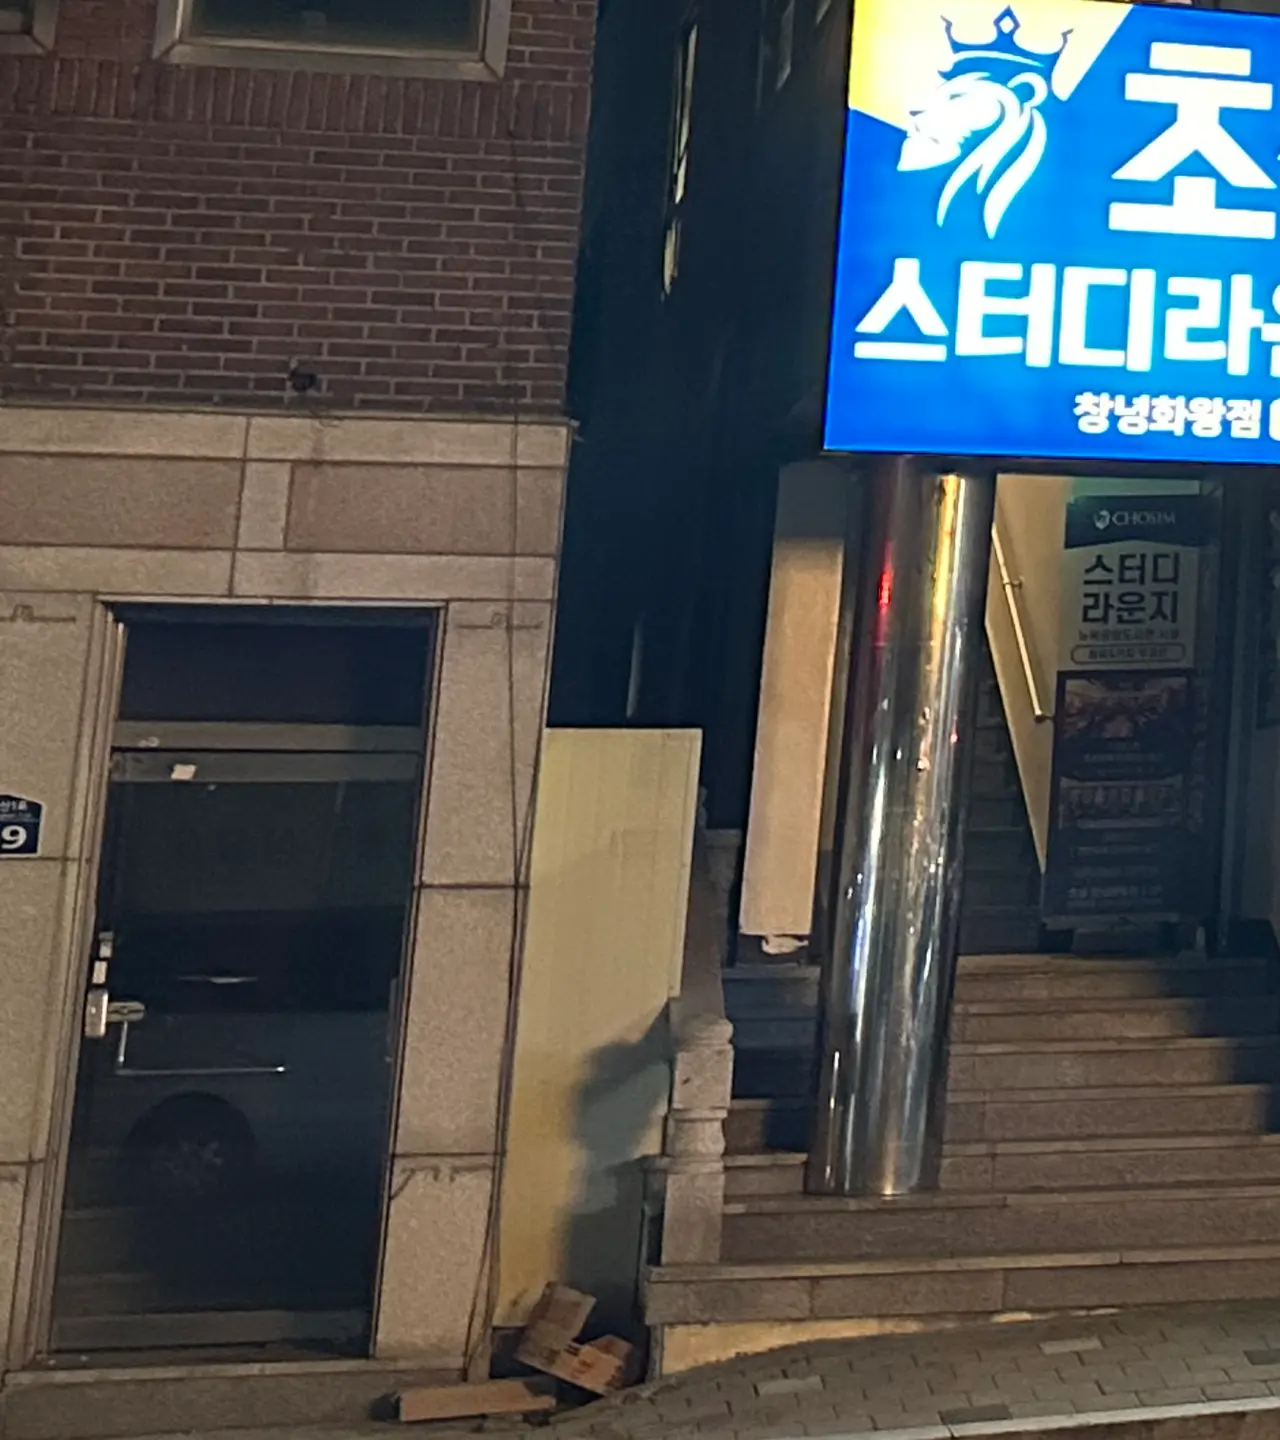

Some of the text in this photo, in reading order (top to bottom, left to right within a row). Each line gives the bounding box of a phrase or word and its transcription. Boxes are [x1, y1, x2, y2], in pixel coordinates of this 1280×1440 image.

[1074, 391, 1263, 439] 창녕화왕점
[1111, 511, 1176, 526] CHOSIM
[1083, 552, 1181, 586] 스터디
[1081, 589, 1180, 625] 라운지
